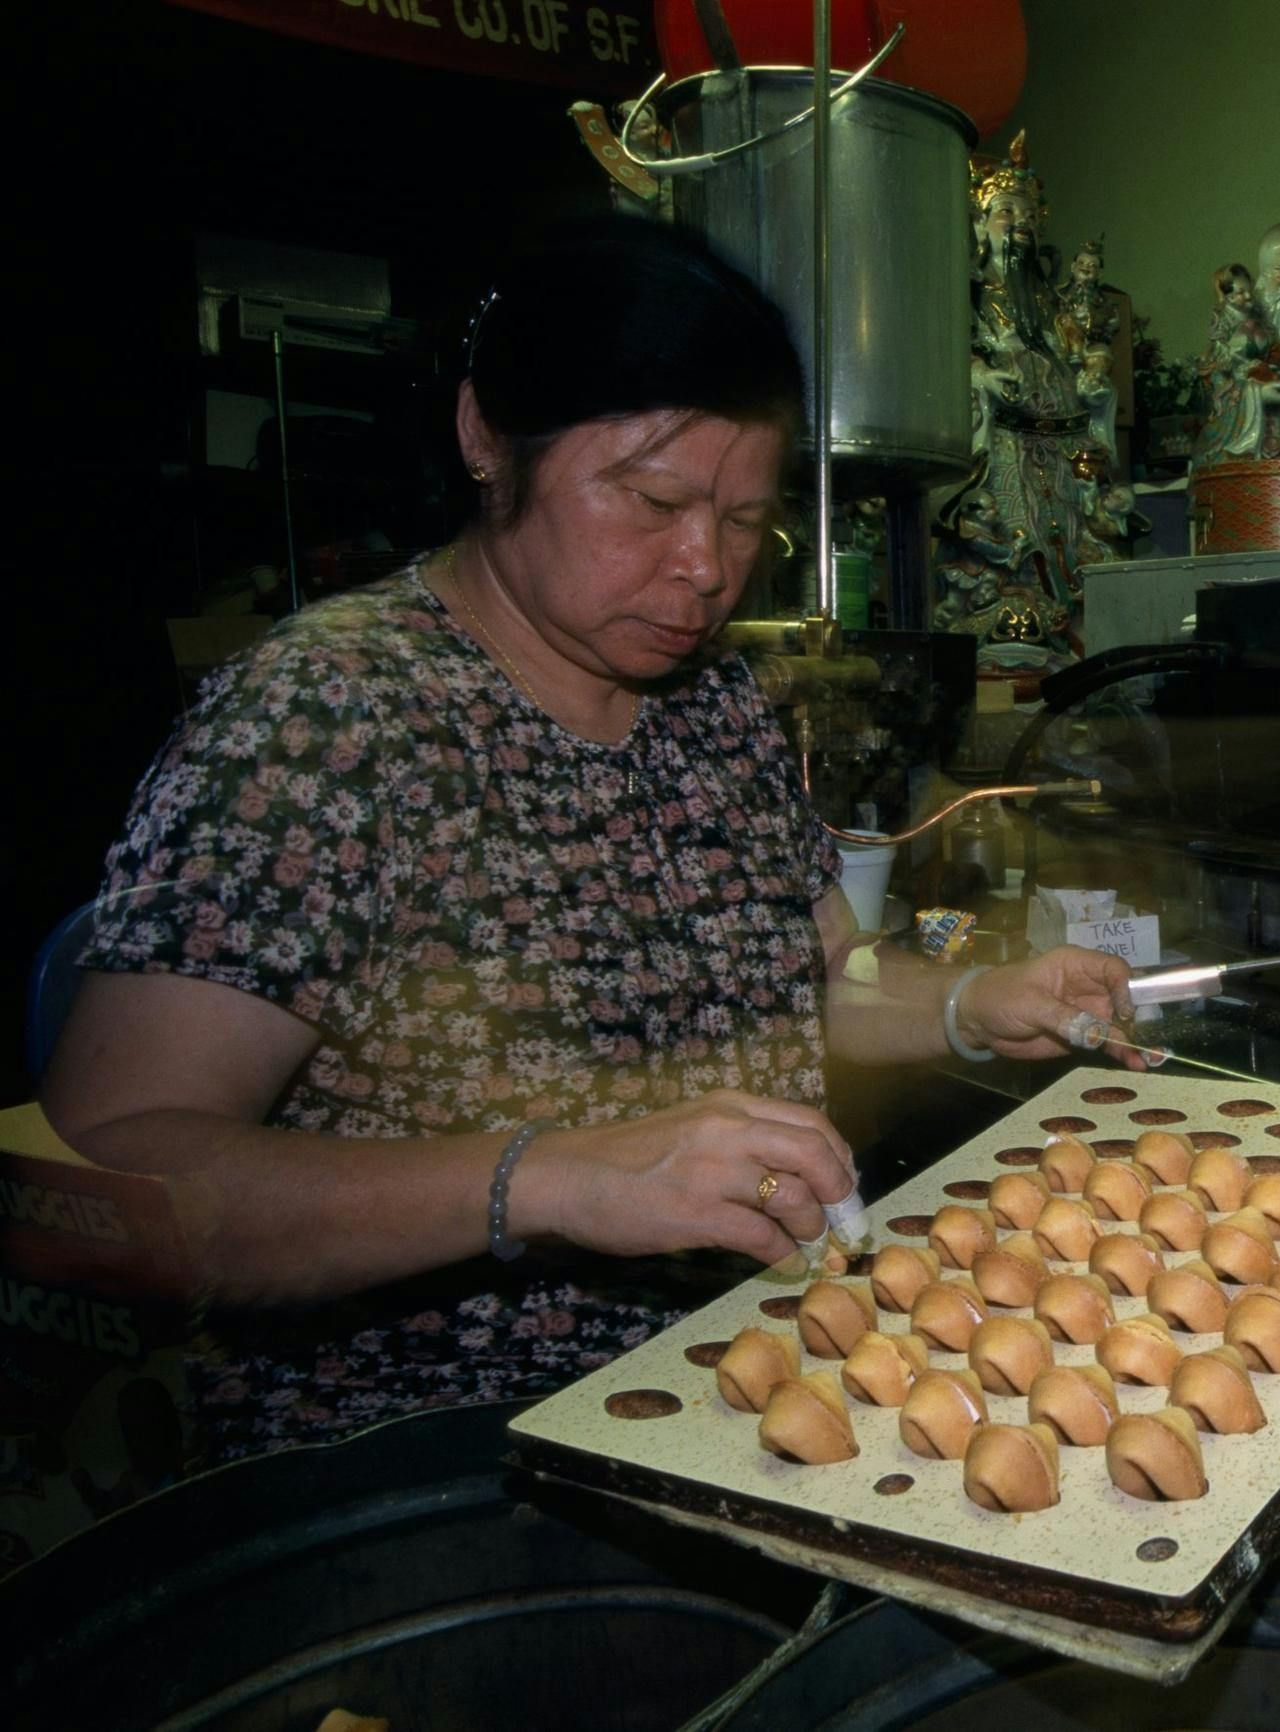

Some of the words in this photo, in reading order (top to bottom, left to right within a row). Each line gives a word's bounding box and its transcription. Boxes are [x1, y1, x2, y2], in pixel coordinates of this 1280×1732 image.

[585, 7, 652, 66] S.F.
[1088, 920, 1137, 940] TAKE
[0, 1179, 127, 1243] UGGIES
